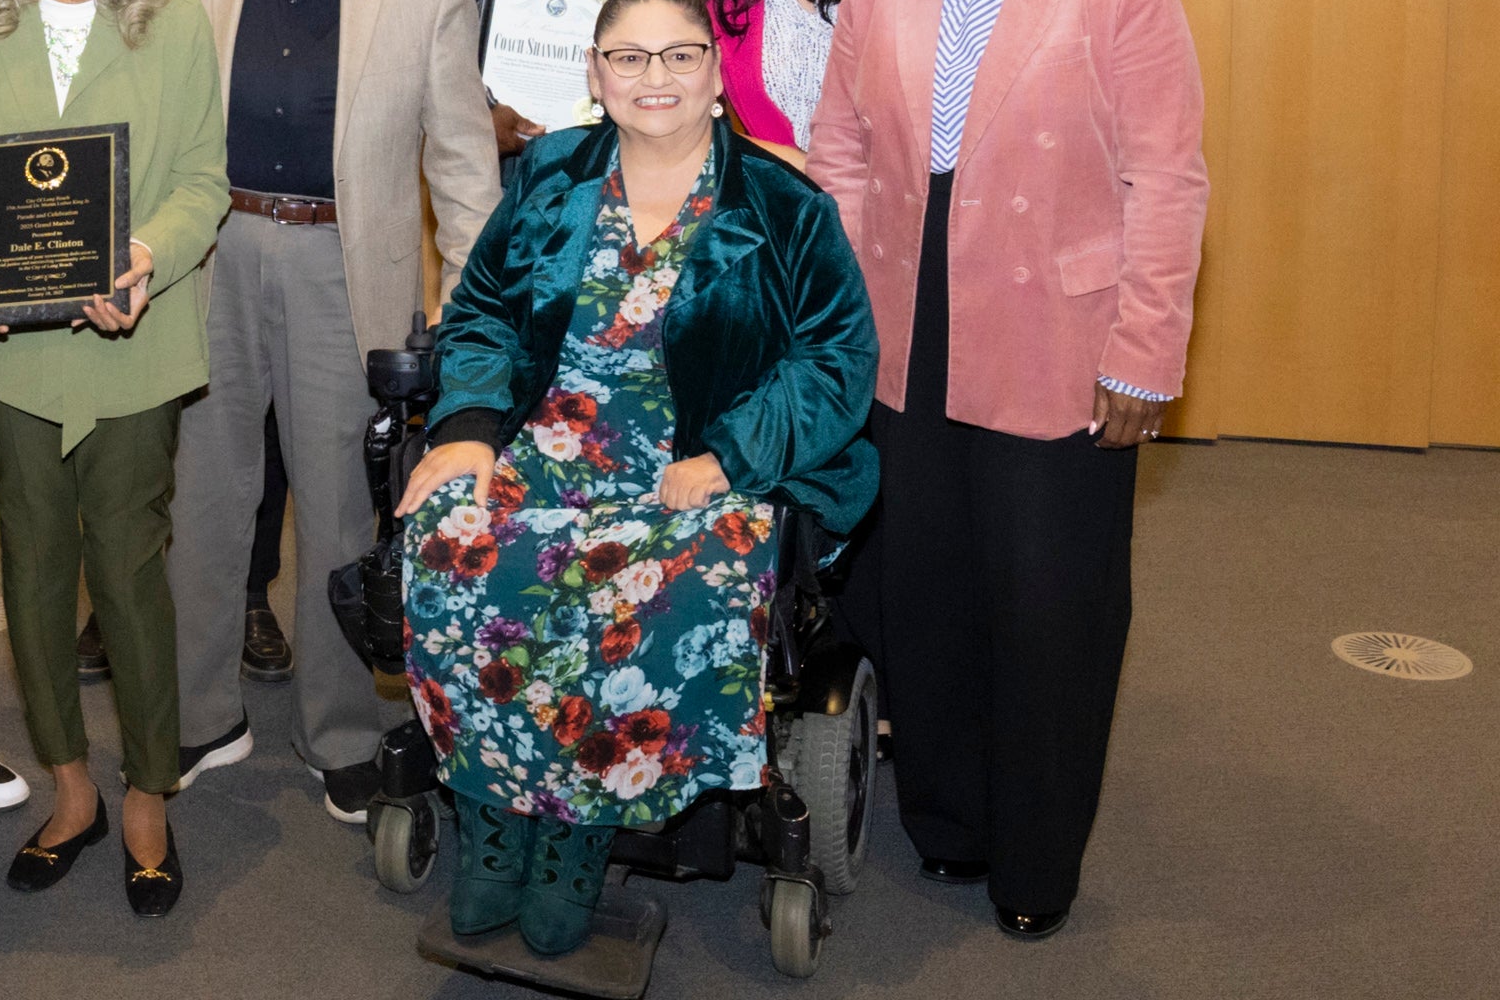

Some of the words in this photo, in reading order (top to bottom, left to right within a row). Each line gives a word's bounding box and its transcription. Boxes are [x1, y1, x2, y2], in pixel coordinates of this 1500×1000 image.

[11, 243, 32, 252] Dale
[34, 242, 45, 250] E.
[47, 240, 83, 249] Clinton
